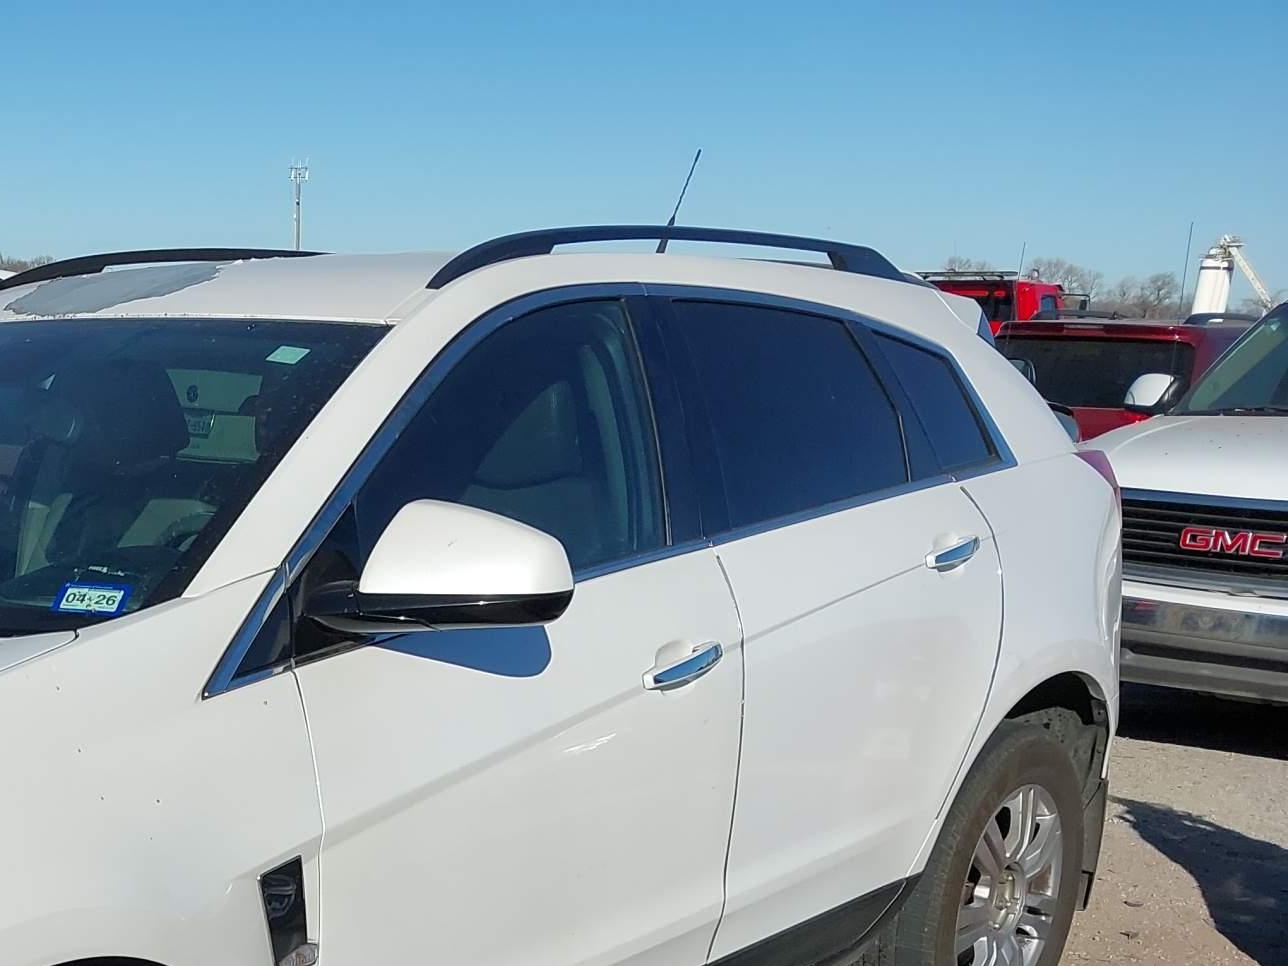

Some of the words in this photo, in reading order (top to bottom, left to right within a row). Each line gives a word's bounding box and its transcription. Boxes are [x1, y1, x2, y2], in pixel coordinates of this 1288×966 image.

[1180, 527, 1287, 558] GMC
[65, 592, 87, 604] 04
[94, 594, 118, 606] 26
